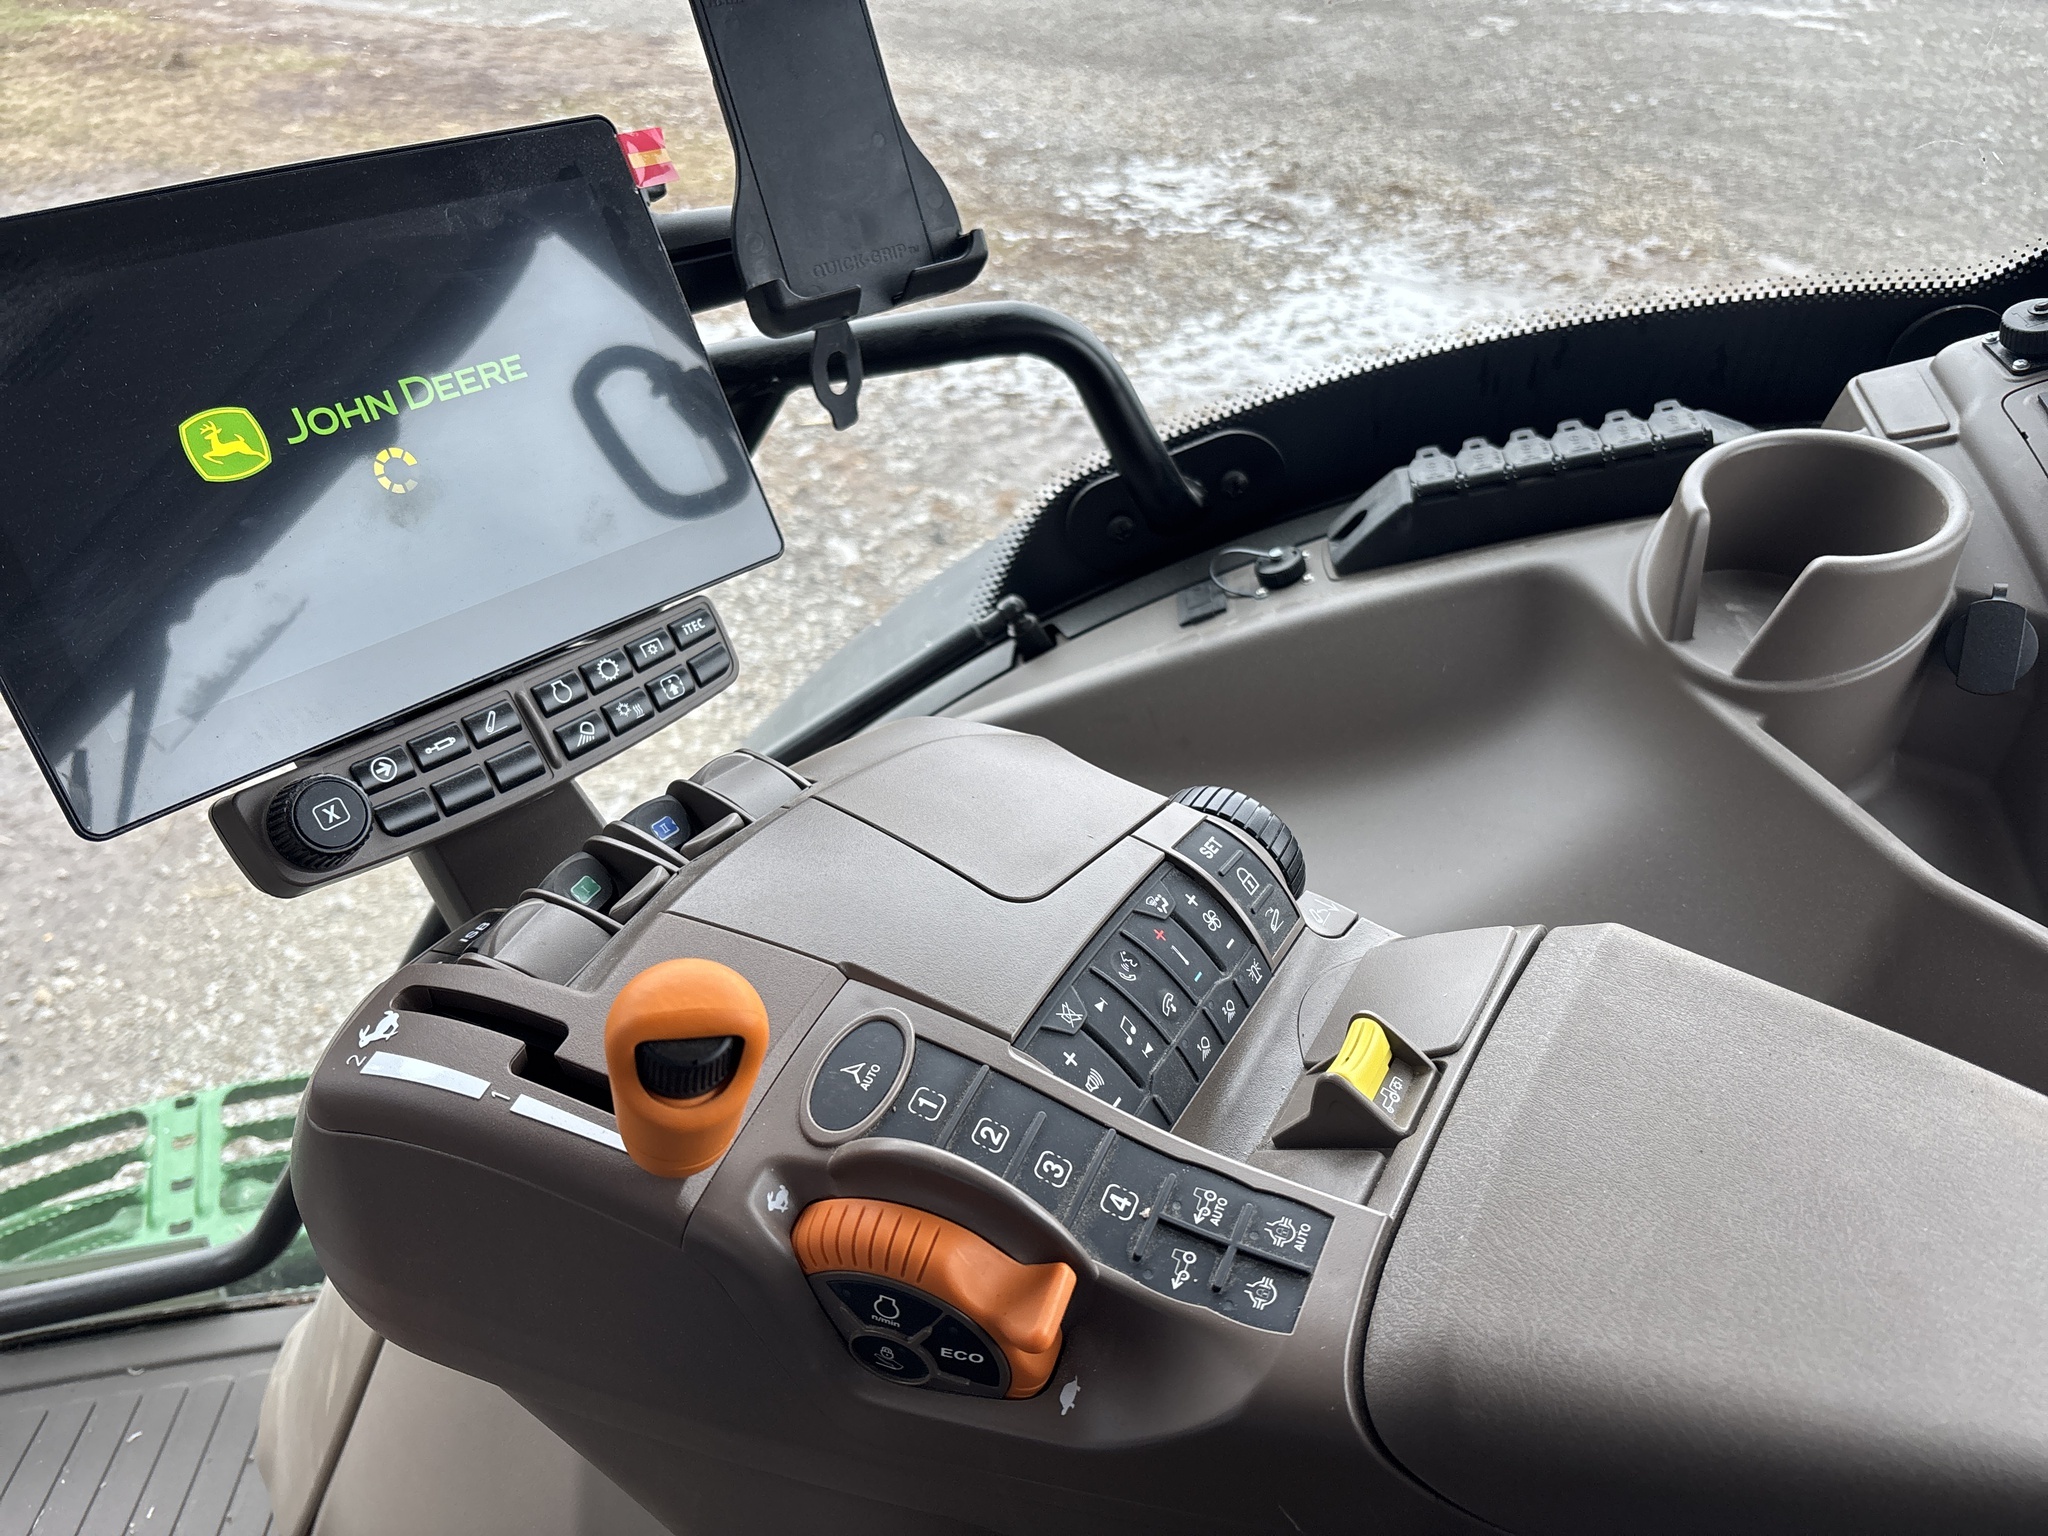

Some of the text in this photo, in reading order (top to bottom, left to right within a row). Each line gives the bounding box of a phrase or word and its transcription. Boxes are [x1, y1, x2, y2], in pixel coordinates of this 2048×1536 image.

[287, 354, 528, 445] JOHN DEERE
[681, 618, 706, 636] iTEC
[1199, 836, 1223, 859] SET
[346, 1054, 367, 1067] 2
[860, 1064, 881, 1092] AUTO
[491, 1090, 511, 1101] 1
[918, 1096, 938, 1110] 1
[980, 1126, 1003, 1147] 2
[1042, 1159, 1065, 1179] 3
[1110, 1194, 1132, 1212] 4
[1209, 1197, 1228, 1227] AUTO
[1293, 1223, 1312, 1252] AUTO
[871, 1314, 901, 1328] n/min
[940, 1347, 984, 1364] ECO
